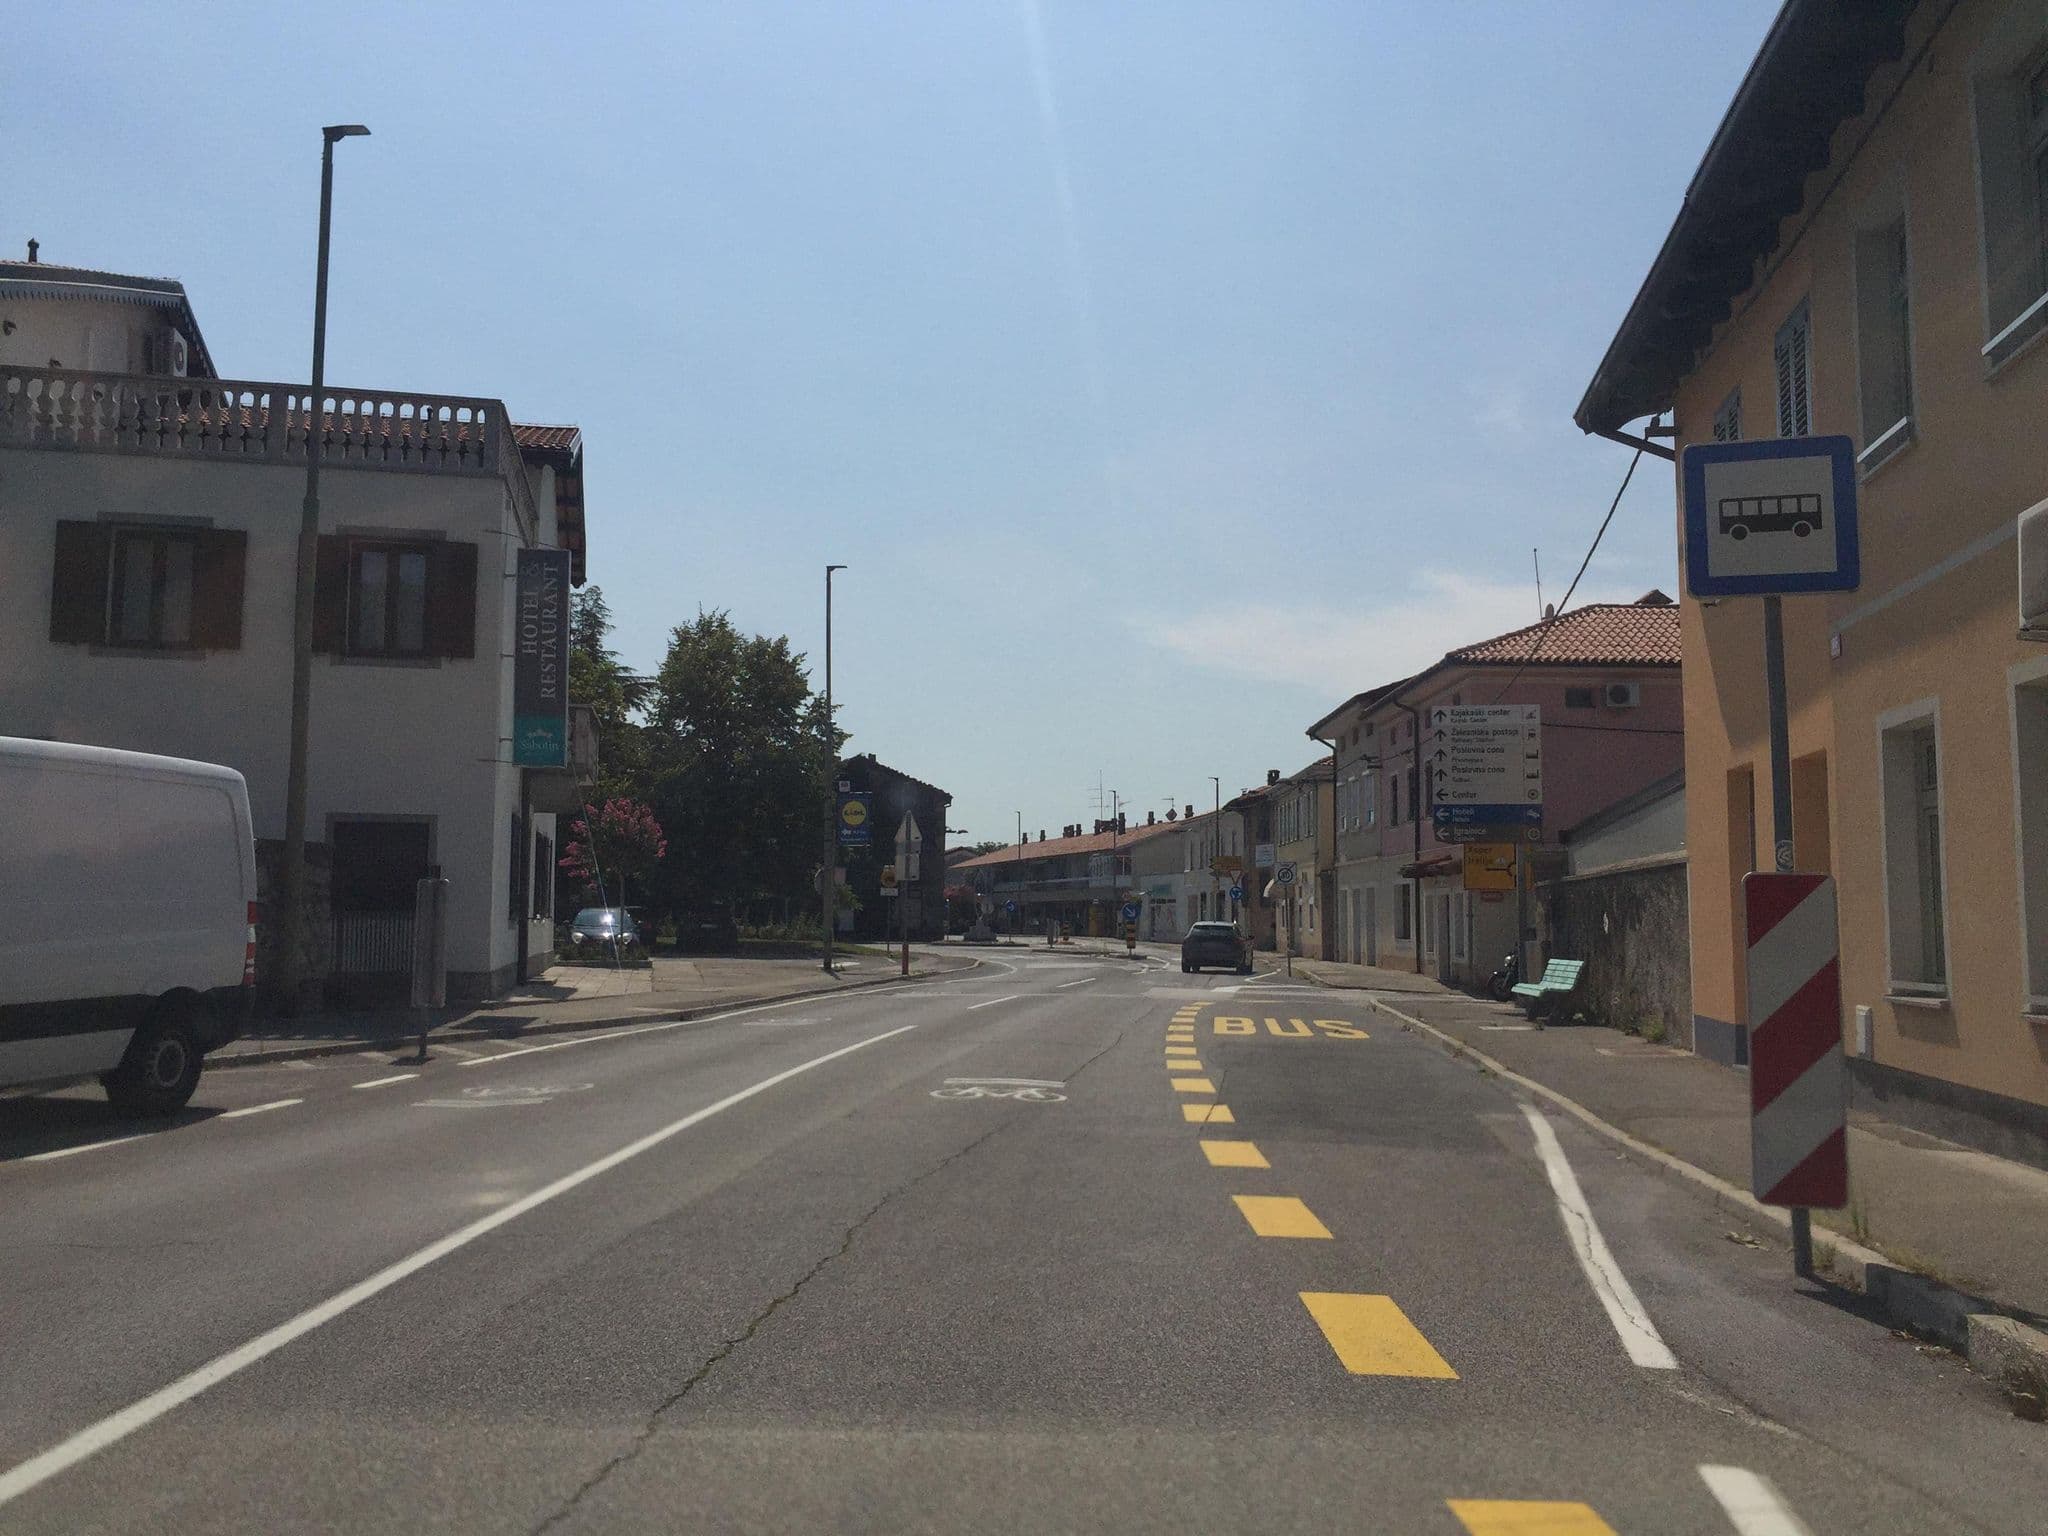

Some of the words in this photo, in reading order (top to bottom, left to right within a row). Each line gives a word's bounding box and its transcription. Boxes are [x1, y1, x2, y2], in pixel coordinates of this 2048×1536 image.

[522, 592, 539, 655] HOTEL
[541, 562, 559, 700] RESTAURANT
[1213, 1016, 1371, 1039] BUS
